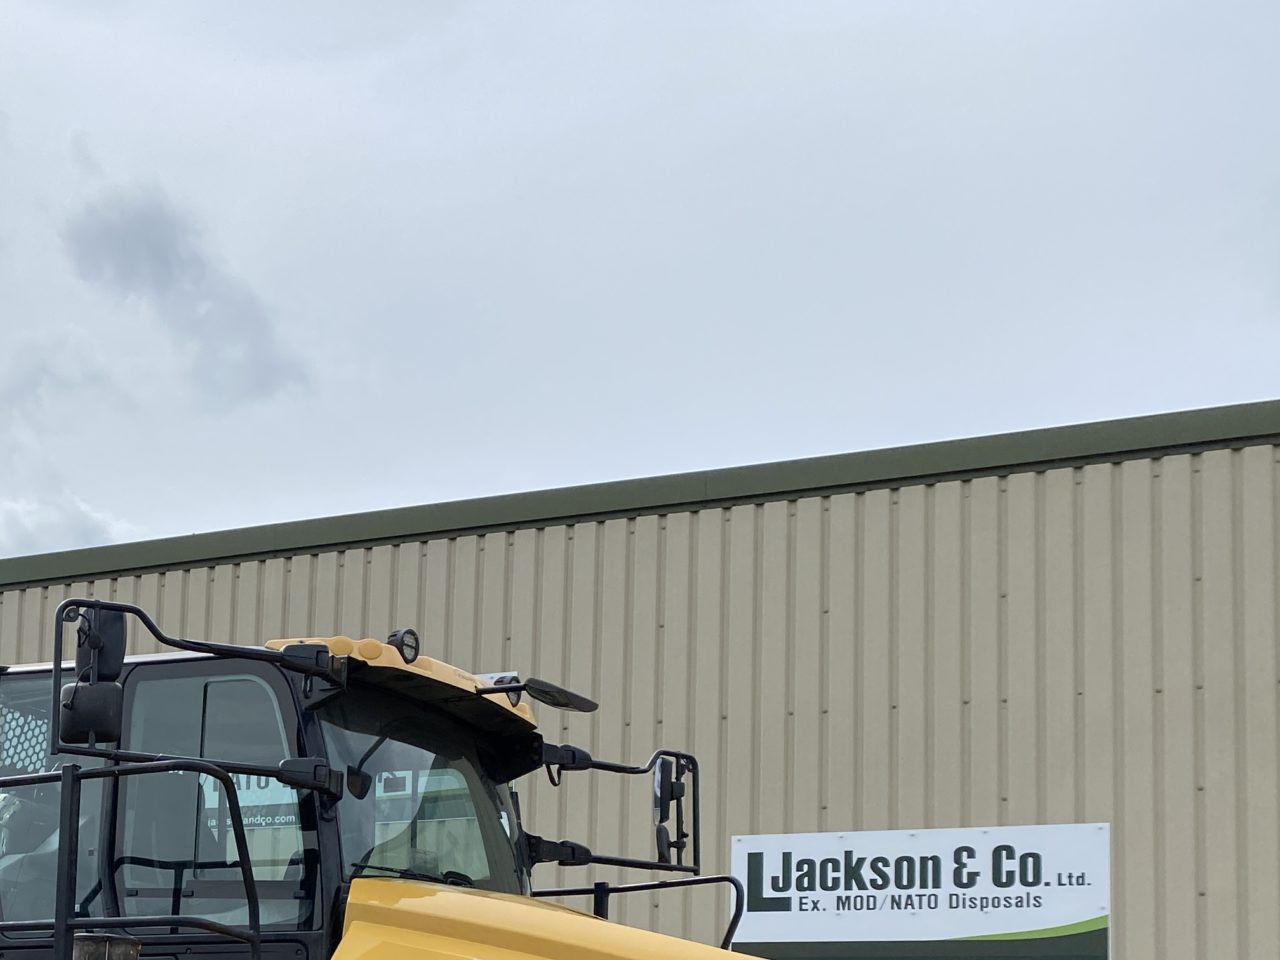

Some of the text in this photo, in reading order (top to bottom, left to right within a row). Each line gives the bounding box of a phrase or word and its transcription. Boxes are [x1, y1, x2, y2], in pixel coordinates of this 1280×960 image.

[953, 845, 981, 889] &
[991, 844, 1051, 888] Co.
[1057, 871, 1093, 888] Ltd.
[798, 891, 1043, 912] Ex. MOD/NATO Disposals
